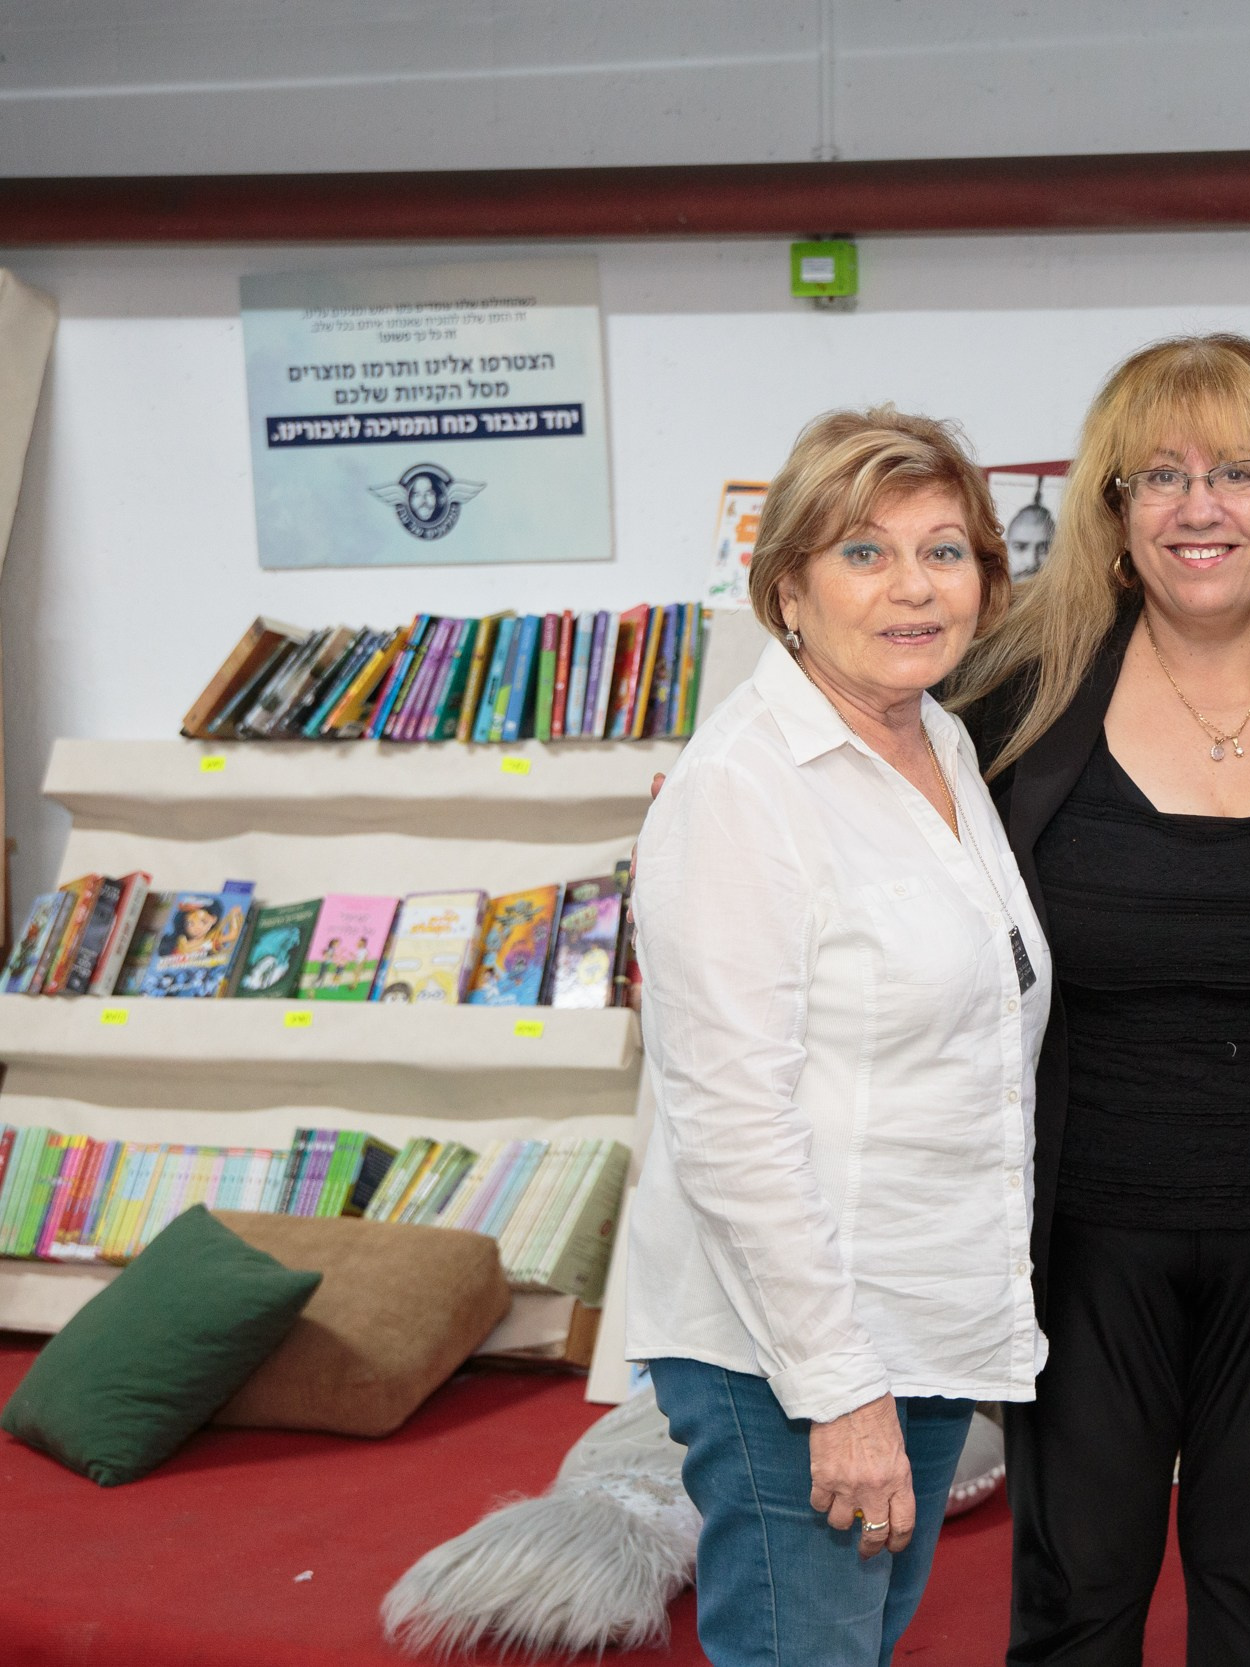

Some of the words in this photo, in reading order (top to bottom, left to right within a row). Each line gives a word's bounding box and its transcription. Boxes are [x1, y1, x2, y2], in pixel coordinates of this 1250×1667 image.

[463, 313, 487, 326] שלנו
[488, 311, 512, 325] הזמן
[428, 327, 442, 340] כל
[443, 329, 456, 340] זה
[288, 362, 357, 383] מוצרים
[362, 359, 420, 379] ותרמו
[425, 354, 473, 376] אלינו
[480, 352, 555, 373] הצטרפו
[335, 384, 389, 405] שלכם
[395, 382, 462, 404] הקניות
[467, 379, 510, 399] מסל
[270, 415, 362, 442] לגיבורינו.
[363, 415, 438, 438] ותמיכה
[440, 414, 478, 434] כוח
[480, 410, 538, 432] נצבור
[540, 409, 579, 429] יחד
